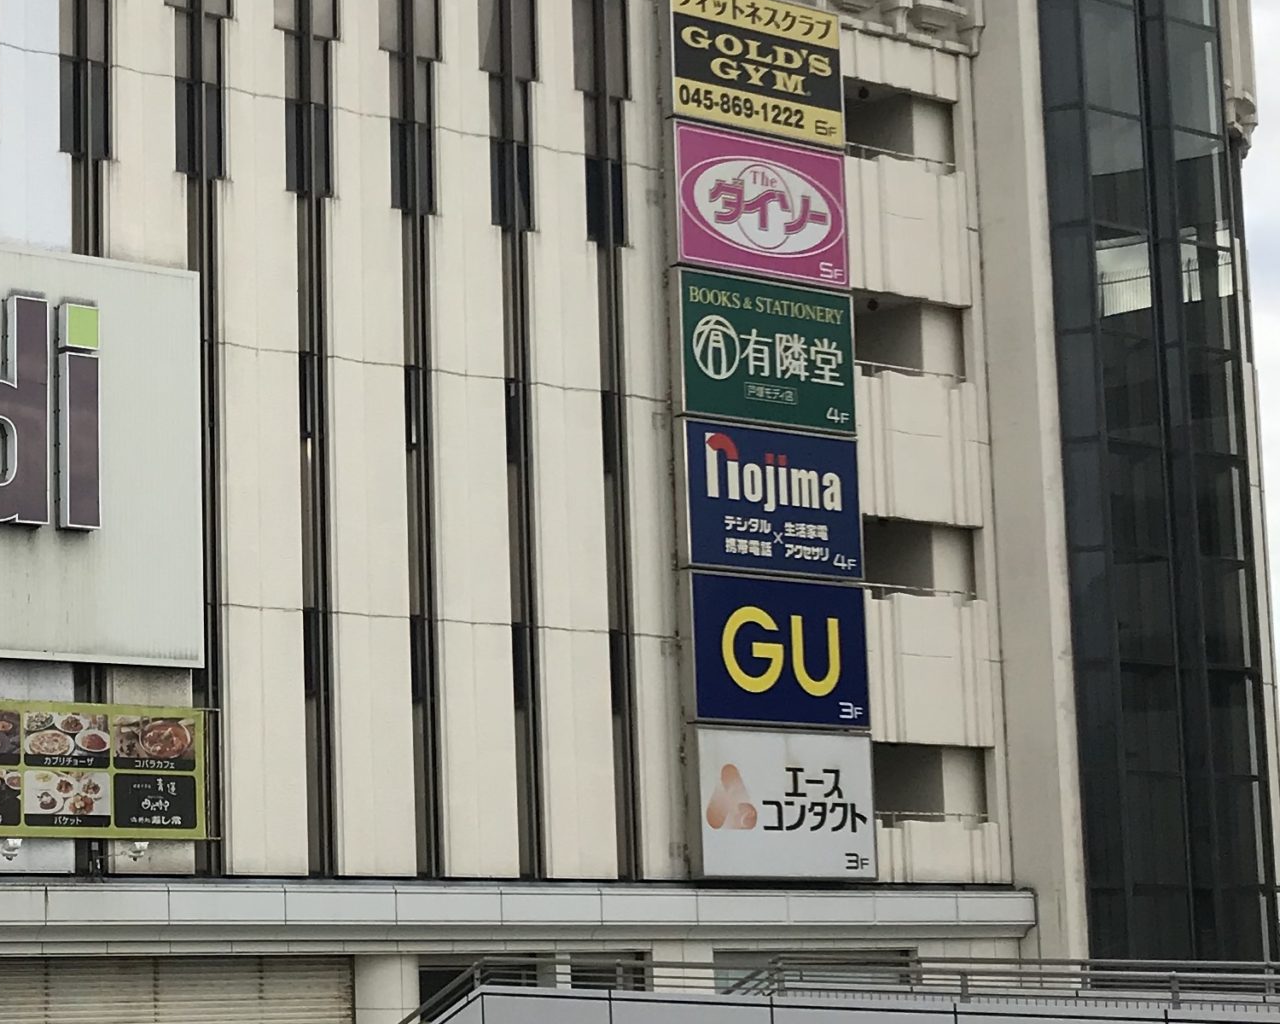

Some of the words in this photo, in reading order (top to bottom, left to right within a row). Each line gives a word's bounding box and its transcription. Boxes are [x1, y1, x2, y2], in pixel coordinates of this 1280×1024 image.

[681, 26, 832, 77] GOLD'S
[711, 58, 806, 96] GYM
[679, 84, 805, 129] 045-869-1222
[814, 120, 837, 136] 6F
[750, 170, 778, 188] The
[709, 178, 828, 235] ダイソー
[819, 262, 844, 279] 5F
[688, 286, 741, 309] BOOKS
[742, 297, 752, 310] &
[755, 296, 844, 325] STATIONERY
[739, 328, 845, 387] 有隣堂
[826, 407, 850, 424] 4F
[705, 432, 842, 512] nojima
[724, 515, 771, 534] デジタル
[833, 553, 857, 570] 4F
[722, 606, 841, 697] GU
[839, 701, 863, 719] 3F
[785, 767, 843, 799] エース
[762, 800, 867, 832] コンタクト
[845, 853, 870, 869] 3F
